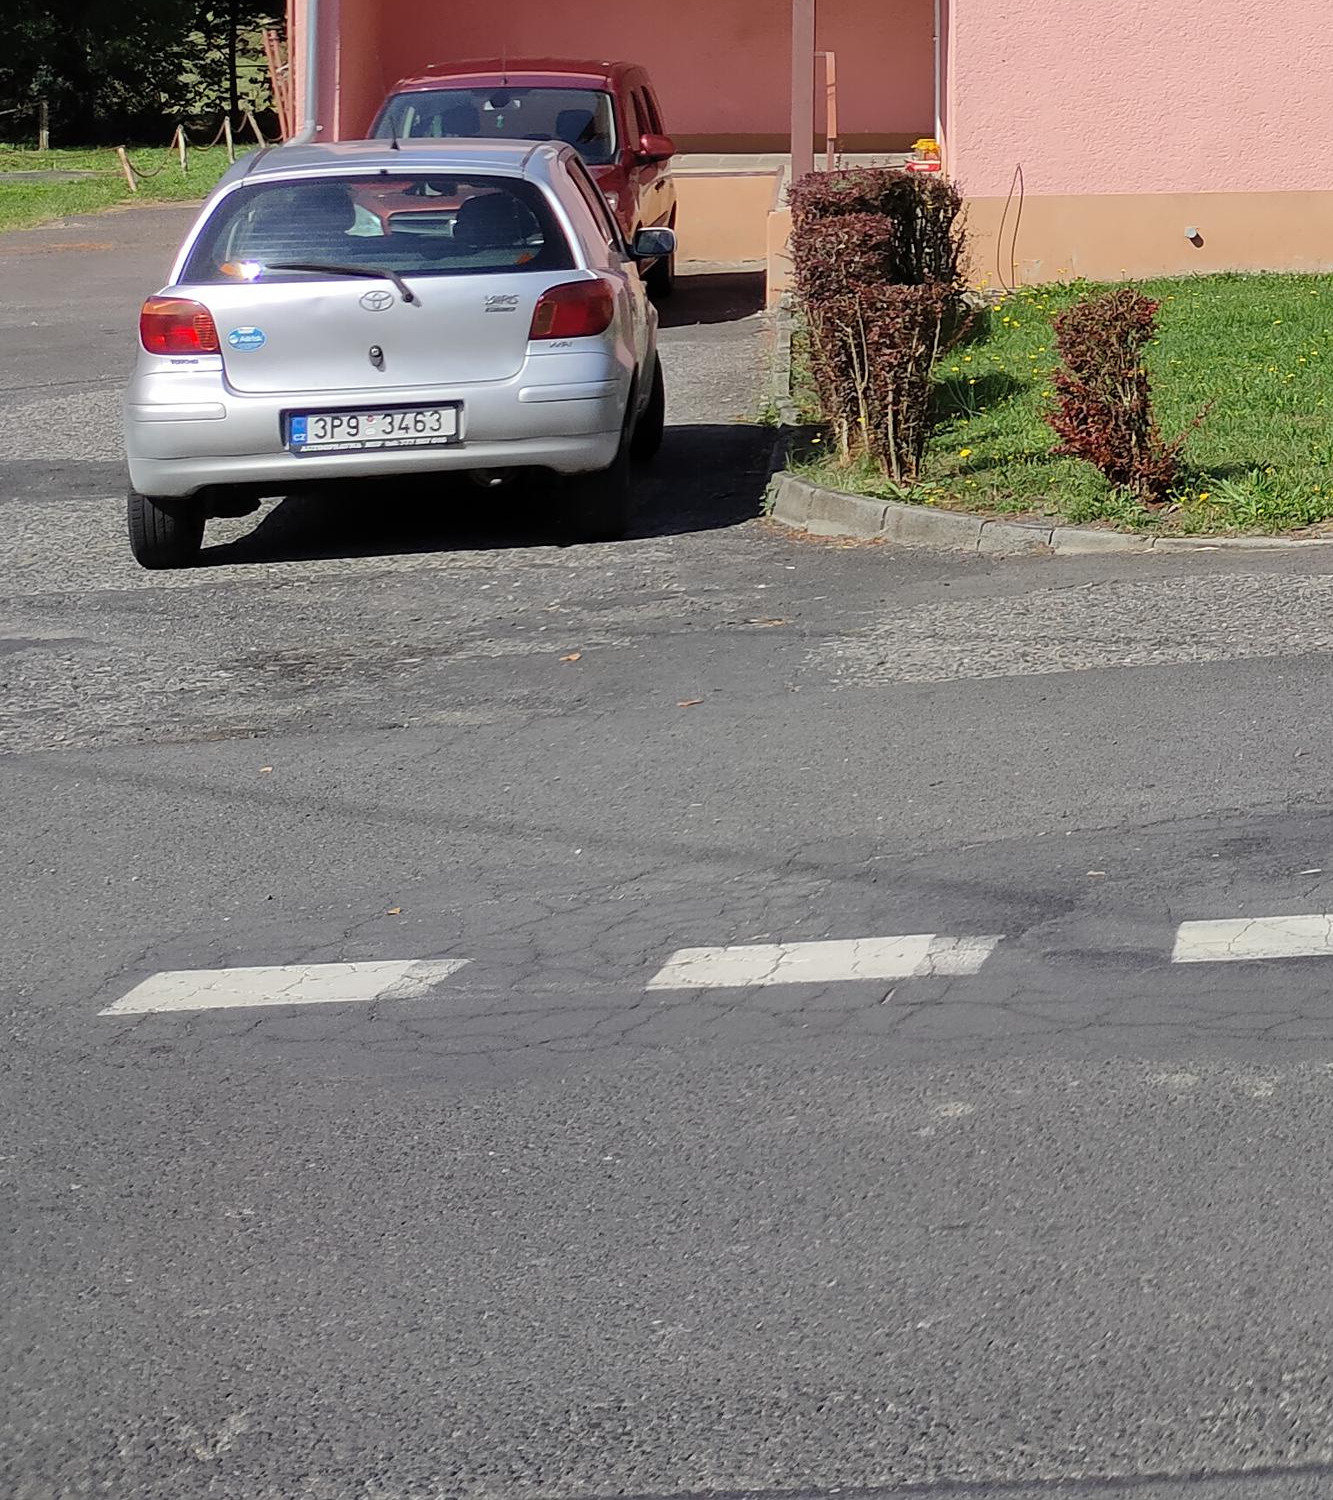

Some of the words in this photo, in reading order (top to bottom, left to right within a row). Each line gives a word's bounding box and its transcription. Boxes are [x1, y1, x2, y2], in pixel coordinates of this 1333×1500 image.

[314, 415, 359, 439] 3P9
[381, 410, 442, 436] 3463
[292, 433, 307, 442] CZ
